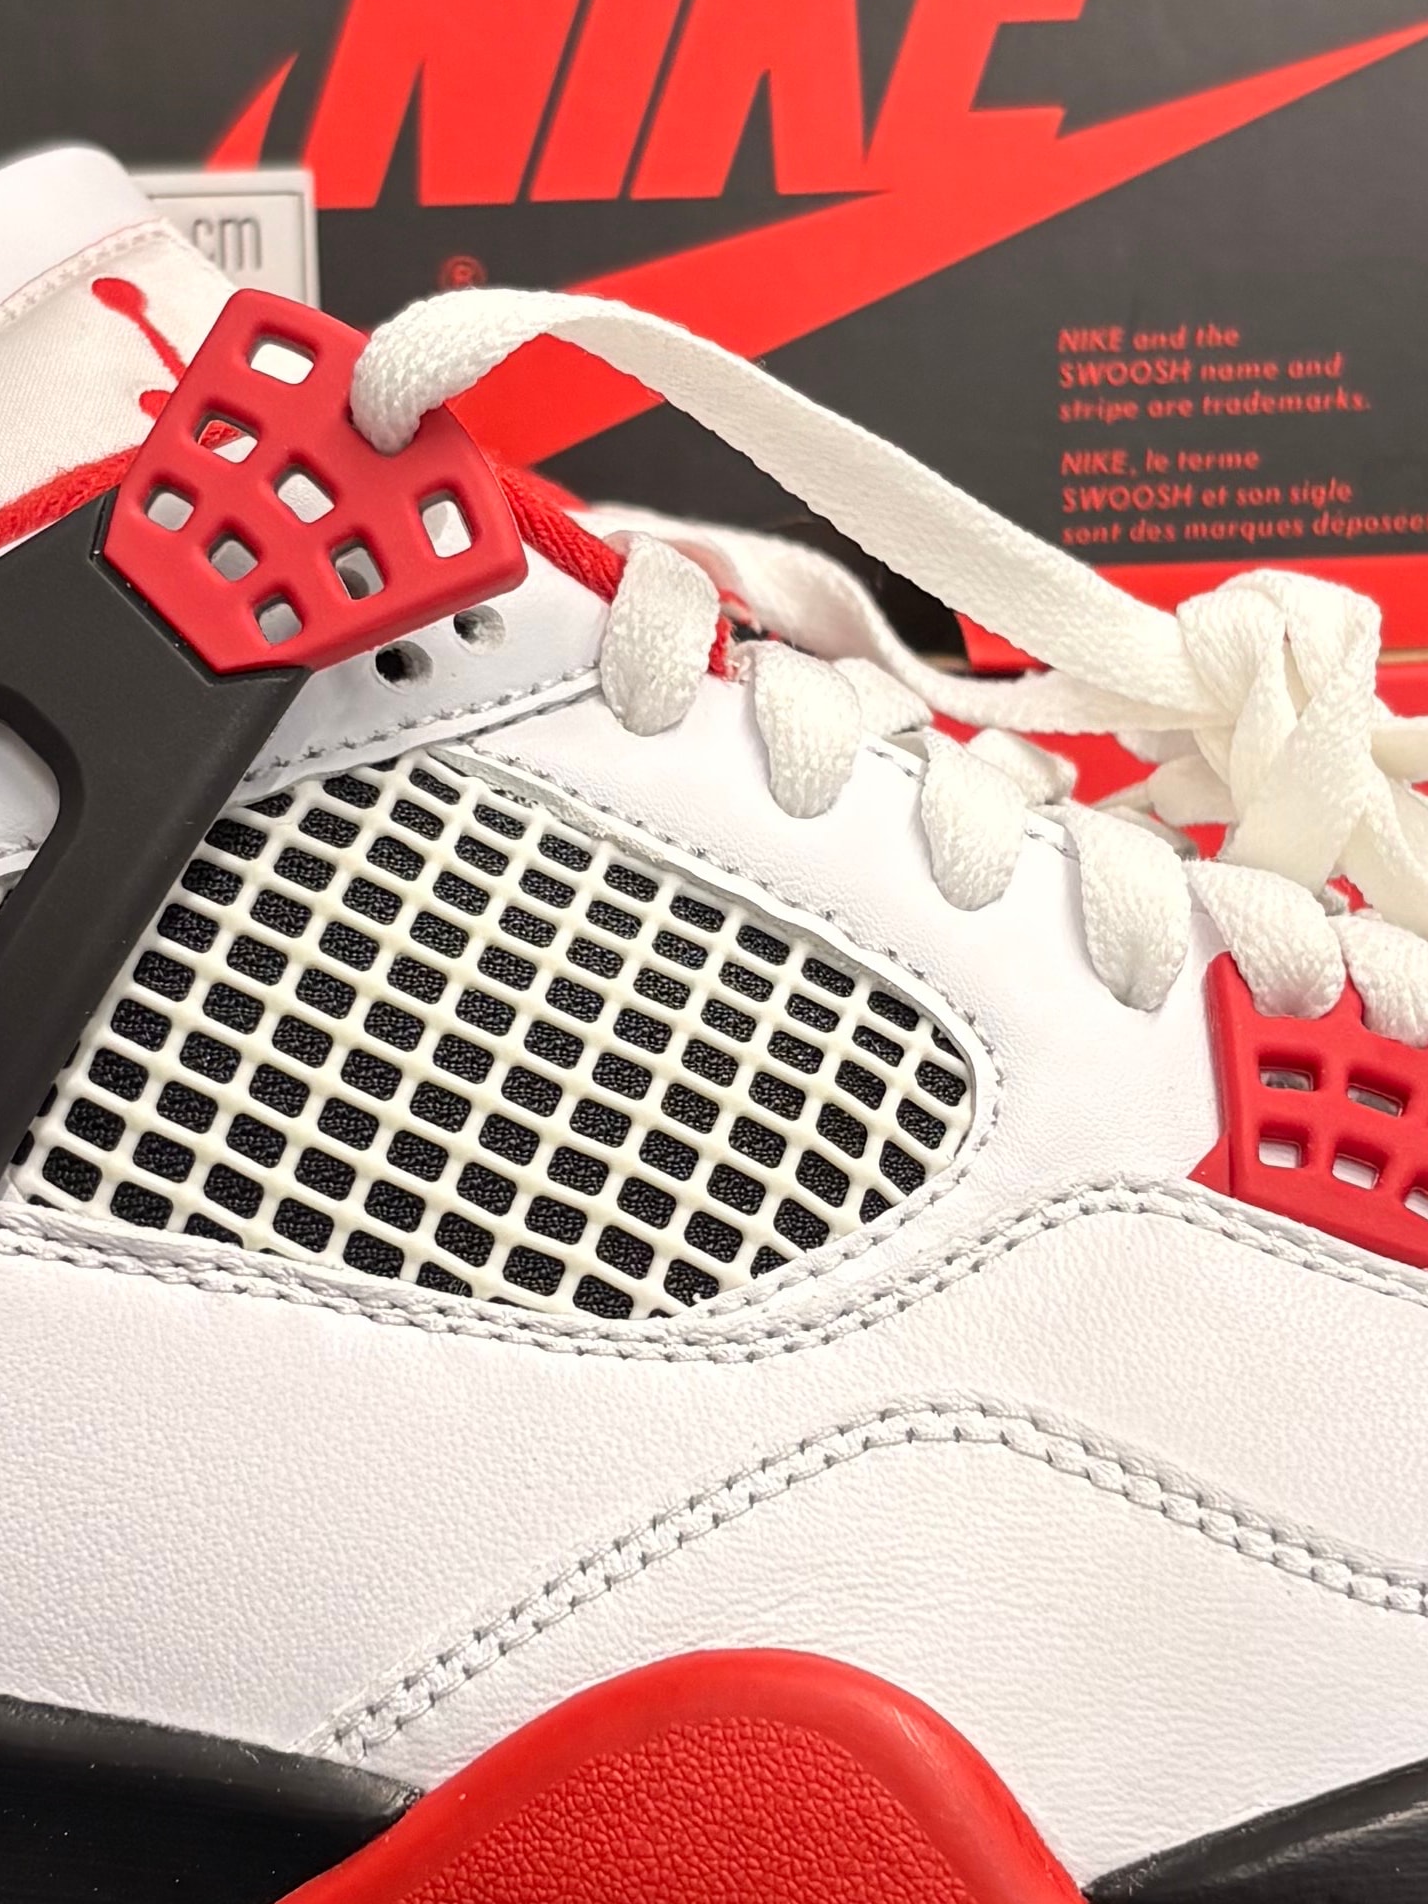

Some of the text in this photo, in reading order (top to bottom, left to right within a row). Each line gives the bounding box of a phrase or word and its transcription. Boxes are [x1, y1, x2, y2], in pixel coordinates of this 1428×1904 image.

[1057, 323, 1241, 354] NIKE and the
[1058, 351, 1344, 388] SWOOSH name and
[1058, 386, 1370, 425] stripe are trademarks.
[1060, 448, 1261, 478] NIKE, le terme
[1061, 476, 1354, 514] SWOOSH et son sigle
[1061, 521, 1123, 547] sont
[1130, 517, 1176, 543] des
[1183, 515, 1305, 544] marques
